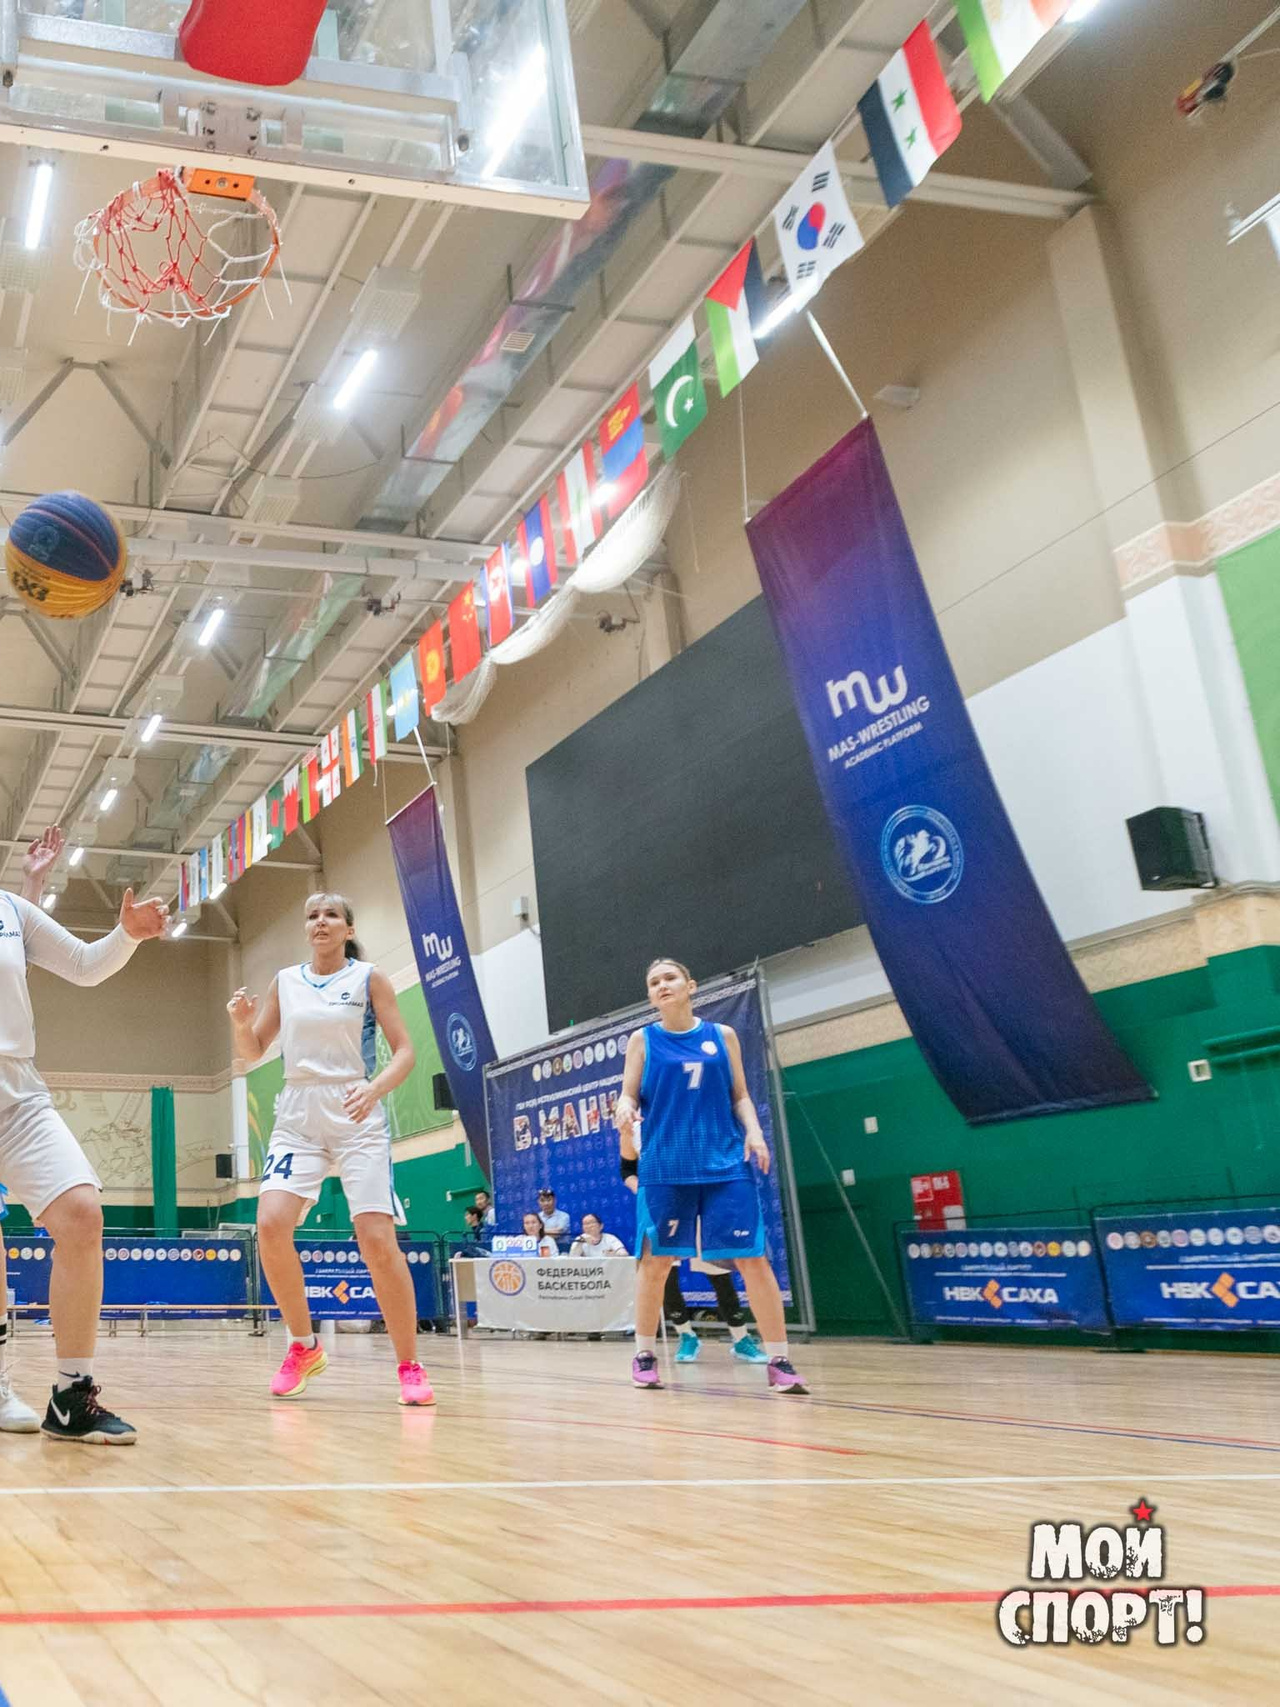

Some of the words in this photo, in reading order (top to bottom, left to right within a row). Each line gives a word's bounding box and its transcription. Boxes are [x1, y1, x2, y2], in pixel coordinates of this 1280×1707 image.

[827, 695, 931, 762] MAS-WRESTLING
[682, 1061, 704, 1090] 7
[513, 1090, 621, 1151] В.МАНЧ
[261, 1153, 294, 1182] 24
[668, 1219, 680, 1237] 7
[536, 1267, 604, 1278] ФЕДЕРАЦИЯ
[349, 1286, 376, 1298] СА
[538, 1280, 612, 1291] БАСКЕТБОЛА
[943, 1286, 984, 1302] НВК
[1002, 1287, 1059, 1303] САХА
[1160, 1282, 1214, 1299] НВК
[1236, 1281, 1280, 1299] СА
